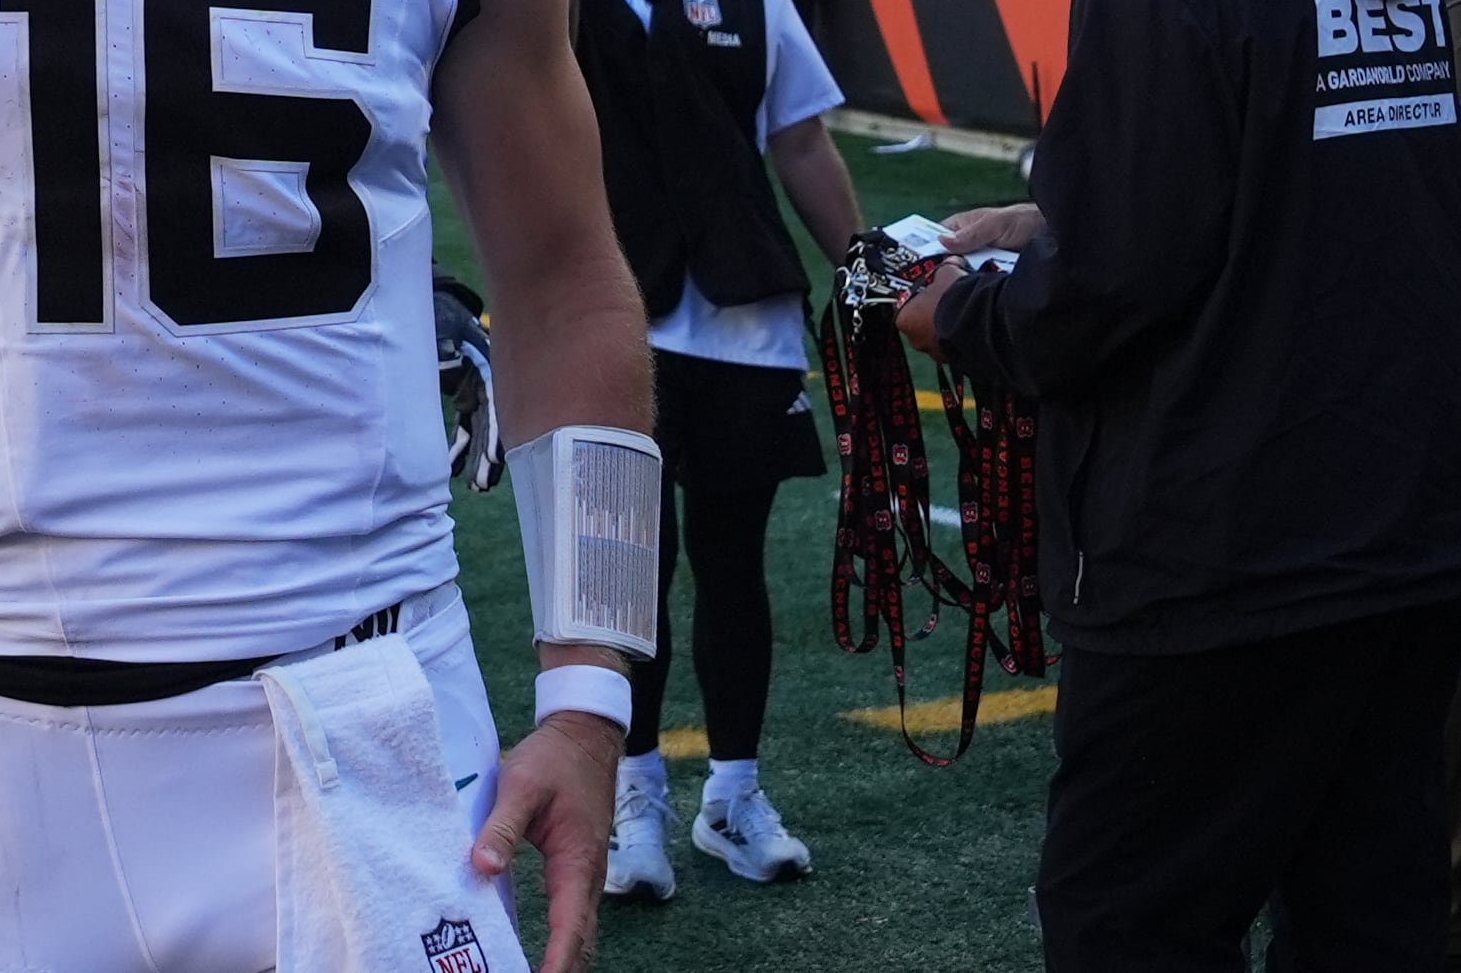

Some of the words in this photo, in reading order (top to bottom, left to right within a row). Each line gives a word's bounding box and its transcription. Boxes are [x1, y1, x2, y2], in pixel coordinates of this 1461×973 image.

[1316, 73, 1327, 92] A
[1327, 64, 1405, 90] GARDAWORLD
[1406, 61, 1451, 83] COMPANY
[1344, 107, 1386, 127] AREA
